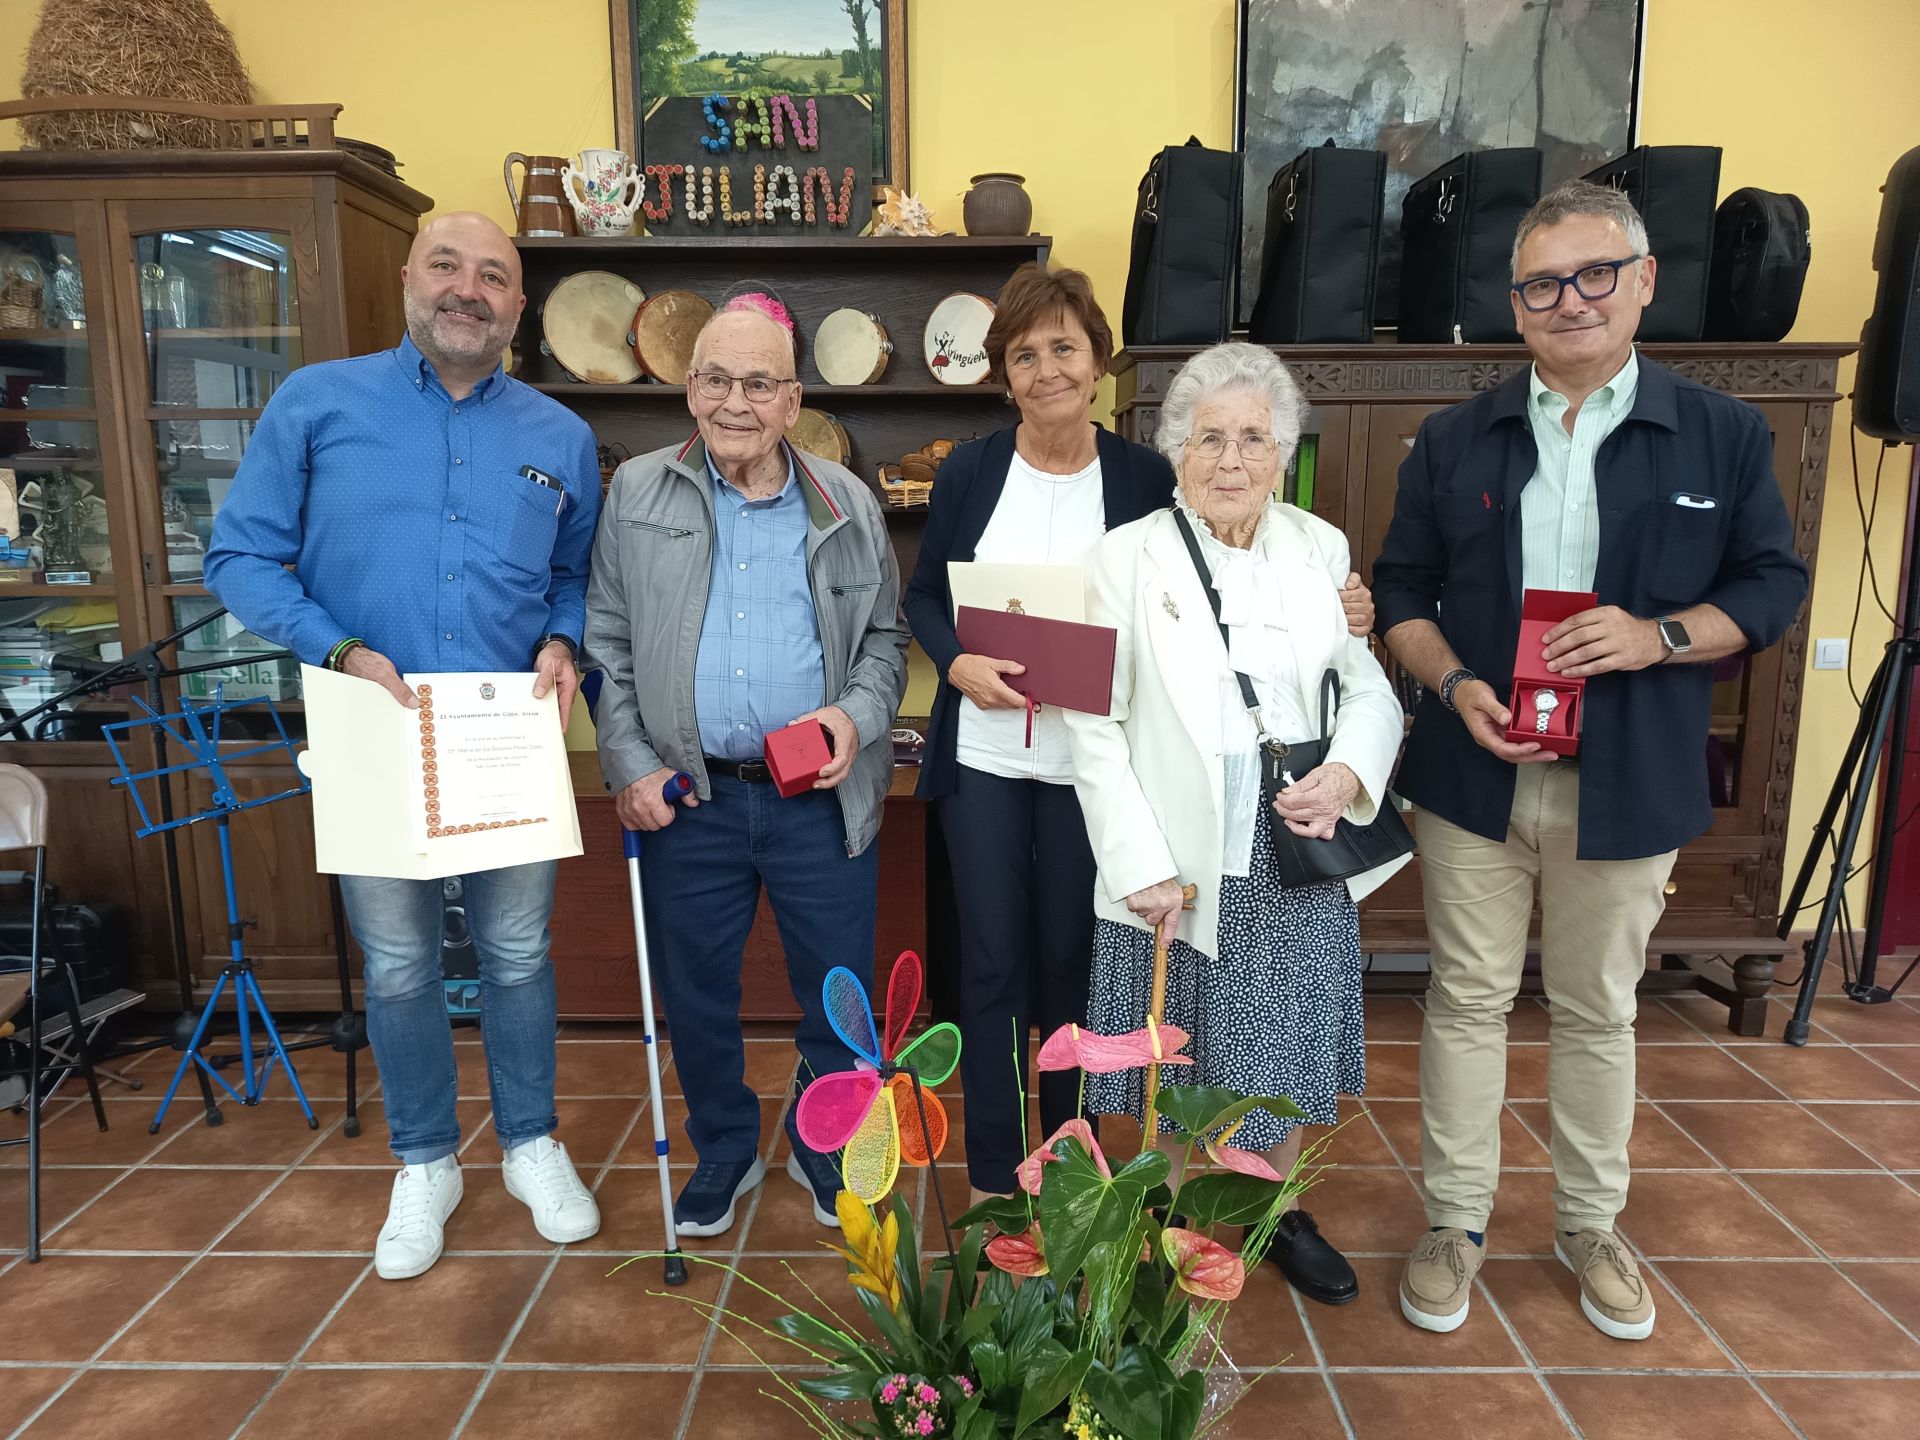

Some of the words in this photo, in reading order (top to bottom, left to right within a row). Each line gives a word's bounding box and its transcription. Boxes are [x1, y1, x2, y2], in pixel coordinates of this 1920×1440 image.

[701, 91, 819, 150] SAN
[643, 163, 855, 228] JULIAN
[1350, 364, 1470, 391] BIBLIOTECA
[220, 663, 273, 685] Sella
